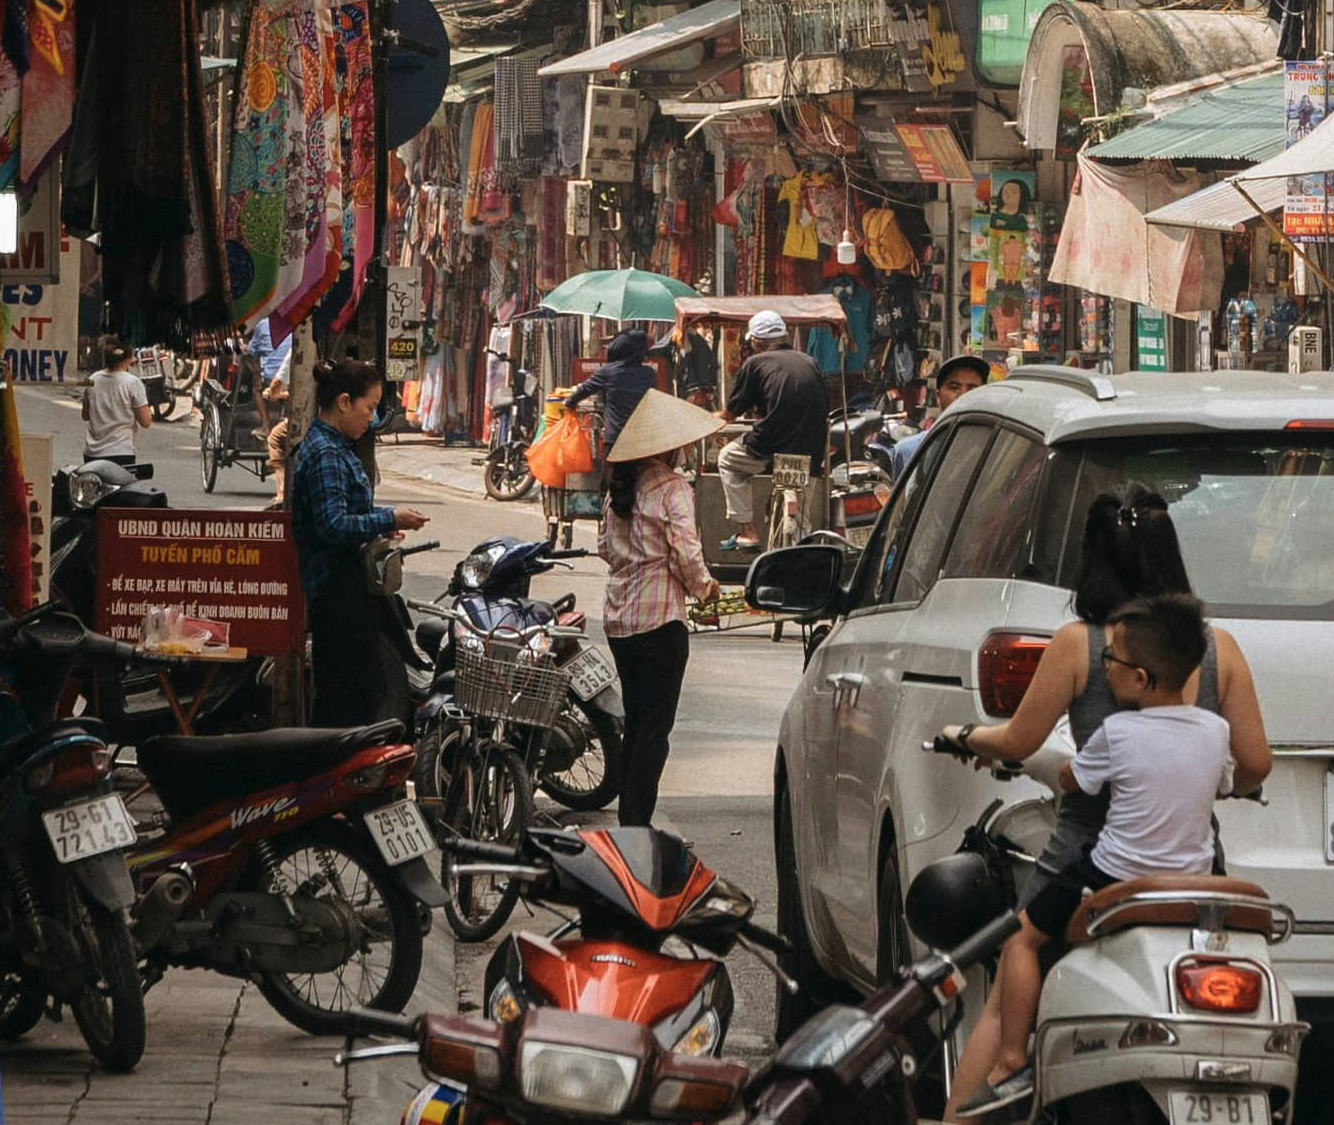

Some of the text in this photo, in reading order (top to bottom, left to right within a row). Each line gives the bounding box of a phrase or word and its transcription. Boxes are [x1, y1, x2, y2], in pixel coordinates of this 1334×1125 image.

[118, 518, 284, 539] UBND QUẬN HOÀN KIẾM
[141, 542, 187, 563] TUYẾN
[192, 544, 222, 564] PHỐ
[124, 579, 134, 591] XE
[155, 579, 165, 592] XE
[187, 579, 208, 593] TRÊN
[219, 606, 246, 619] DOANH
[271, 605, 288, 620] BÁN
[230, 797, 297, 829] Wave
[374, 805, 416, 836] 29-U5
[56, 822, 127, 858] 721.43
[386, 829, 427, 859] 0101
[1185, 1094, 1254, 1124] 29-B1
